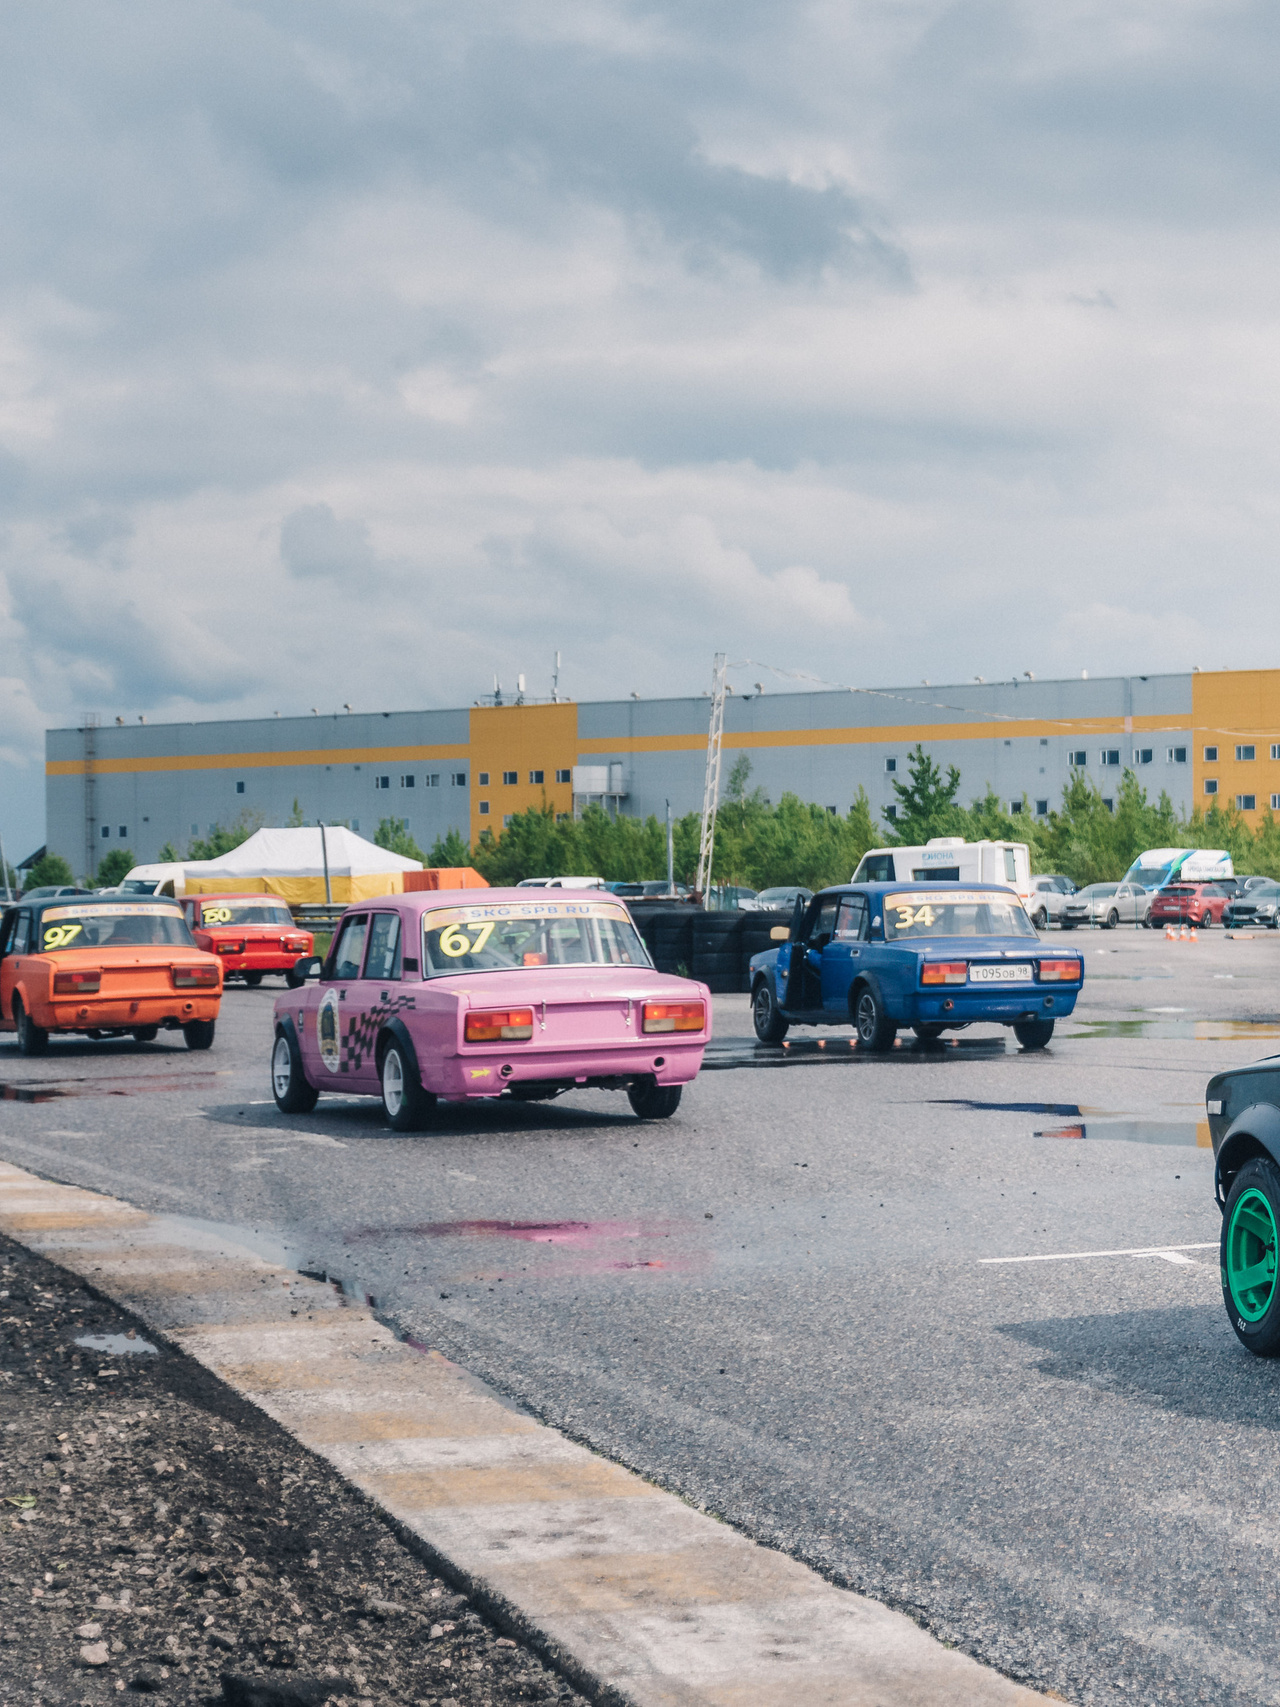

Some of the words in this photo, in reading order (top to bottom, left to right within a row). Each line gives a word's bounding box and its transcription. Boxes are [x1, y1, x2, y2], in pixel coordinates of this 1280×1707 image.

[895, 905, 935, 929] 34
[44, 925, 82, 950] 97
[439, 921, 496, 957] 67
